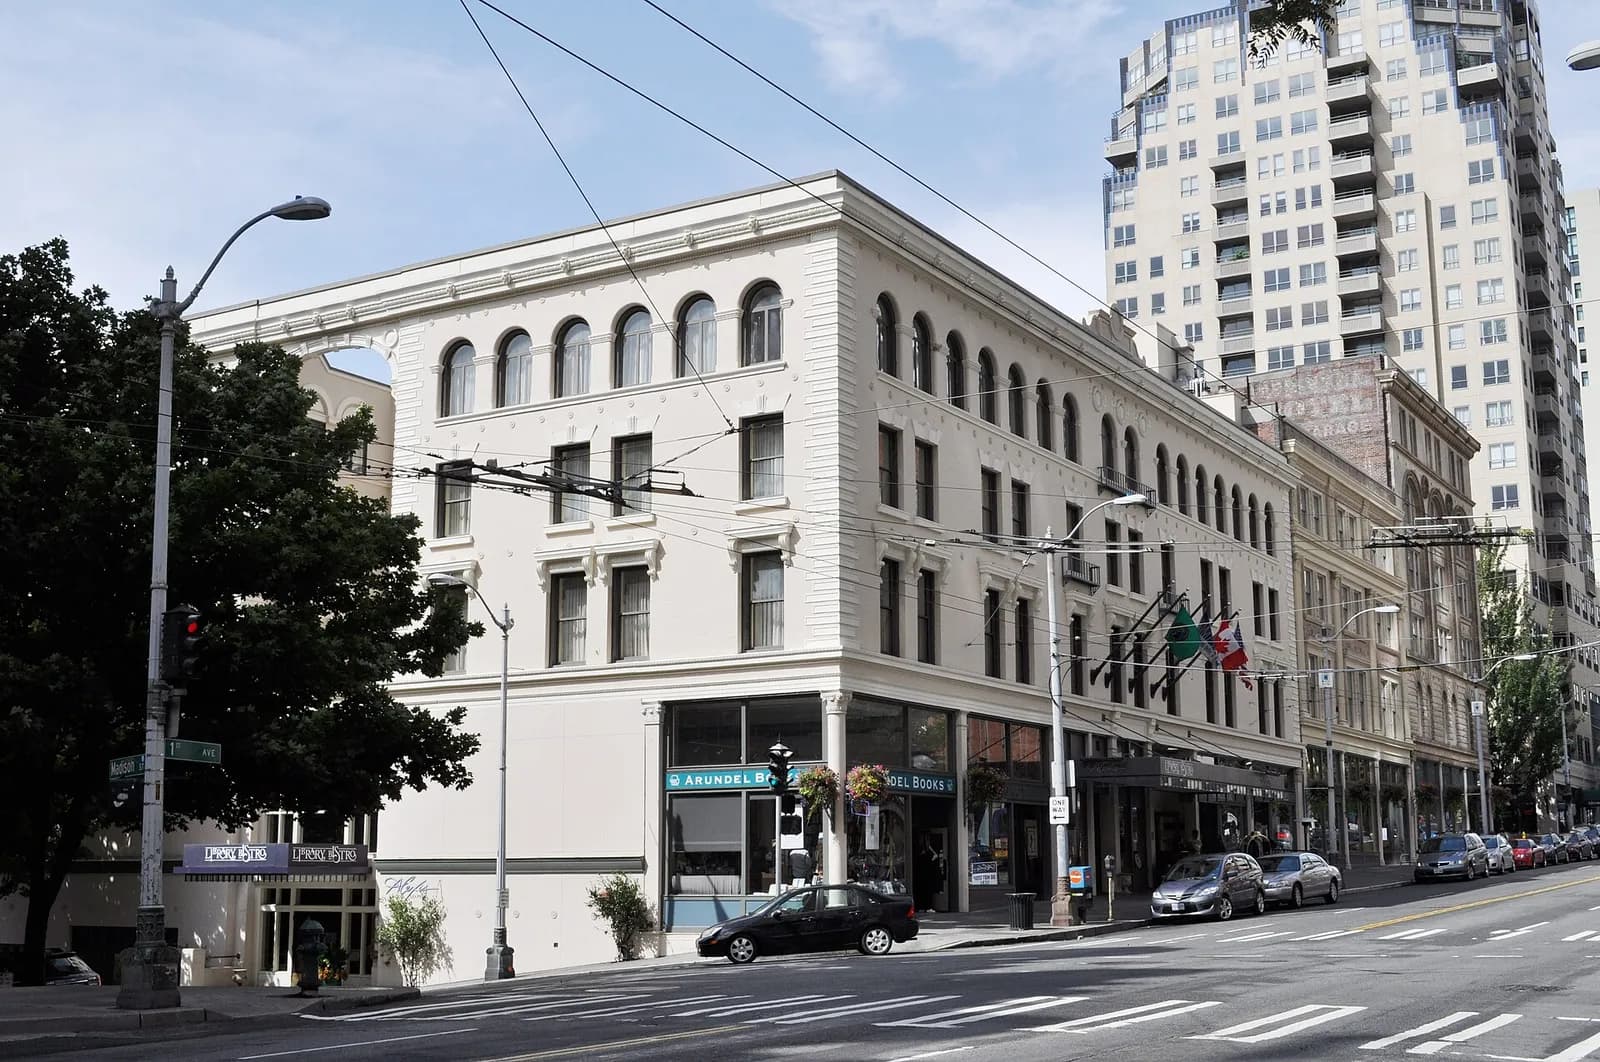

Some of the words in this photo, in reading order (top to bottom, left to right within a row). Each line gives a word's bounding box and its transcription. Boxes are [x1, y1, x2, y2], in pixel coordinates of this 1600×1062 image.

[202, 748, 216, 758] AVE
[111, 759, 135, 777] Madison
[685, 773, 750, 785] ARUNDEL
[912, 776, 945, 791] BOOKS
[204, 846, 236, 862] LIBRARY
[238, 844, 267, 863] BISTRO
[292, 847, 325, 862] LIBRARY
[328, 845, 357, 864] BISTRO
